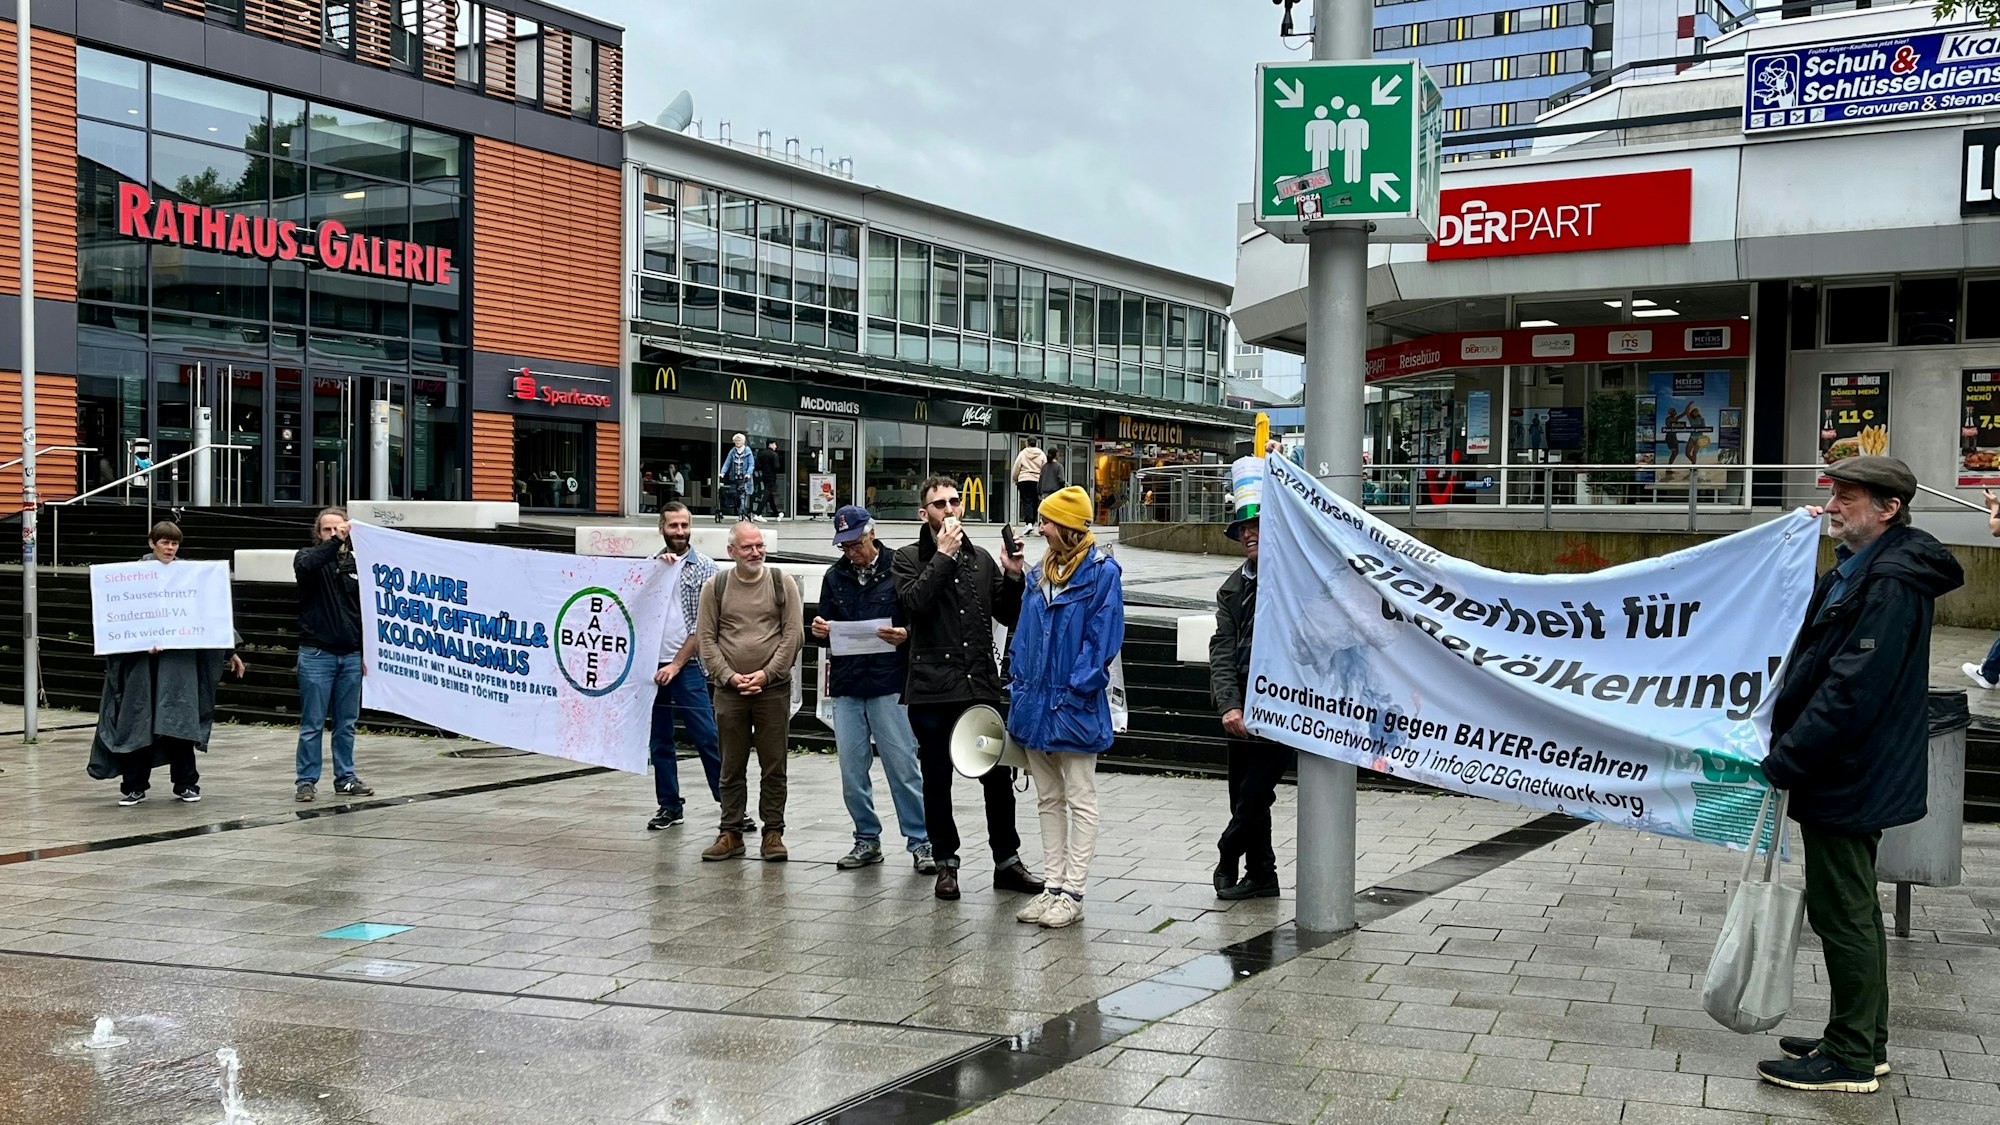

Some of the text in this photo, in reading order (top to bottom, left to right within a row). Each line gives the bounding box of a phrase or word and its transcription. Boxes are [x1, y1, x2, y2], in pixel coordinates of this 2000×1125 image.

[1803, 45, 1921, 78] Schuh &
[1844, 100, 1919, 117] Gravuren
[1921, 96, 1937, 111] &
[1965, 144, 2000, 202] L
[118, 181, 452, 285] RATHAUS-GALERIE
[1621, 339, 1639, 348] ITS
[1400, 350, 1440, 370] Reisebüro
[1675, 378, 1703, 386] MEIERS
[1831, 374, 1880, 386] LORD DÖNER
[1966, 385, 2000, 393] CURRY
[541, 386, 611, 407] Sparkasse
[1831, 387, 1879, 396] DÖNER MENÜ
[1966, 393, 1992, 401] MENÜ
[801, 396, 859, 414] McDonald's
[1839, 410, 1860, 423] 11
[1119, 416, 1183, 444] Merzenich
[1269, 457, 1364, 532] Leverkusen
[1369, 525, 1442, 564] mahnt:
[105, 571, 159, 583] Sicherheit
[372, 563, 468, 605] 120 JAHRE
[107, 590, 197, 602] Im Sauseschritt??
[1348, 554, 1606, 640] Sicherheit
[1622, 592, 1701, 639] für
[107, 608, 187, 622] Sondermüll-VA
[108, 631, 122, 641] So
[124, 630, 137, 639] fix
[139, 627, 177, 638] wieder
[562, 629, 628, 654] BAYER
[378, 619, 530, 676] KOLONIALISMUS
[378, 648, 559, 698] SOLIDARITÄT MIT ALLEN OPFERN DES BAYER
[378, 661, 509, 705] KONZERNS UND SEINER TÖCHTER
[1255, 674, 1378, 724] Coordination
[1383, 711, 1448, 742] gegen
[1453, 723, 1648, 783] BAYER-Gefahren
[1251, 706, 1420, 769] www.CBGnetwork.org
[1431, 750, 1645, 818] info@CBGnetwork.org
